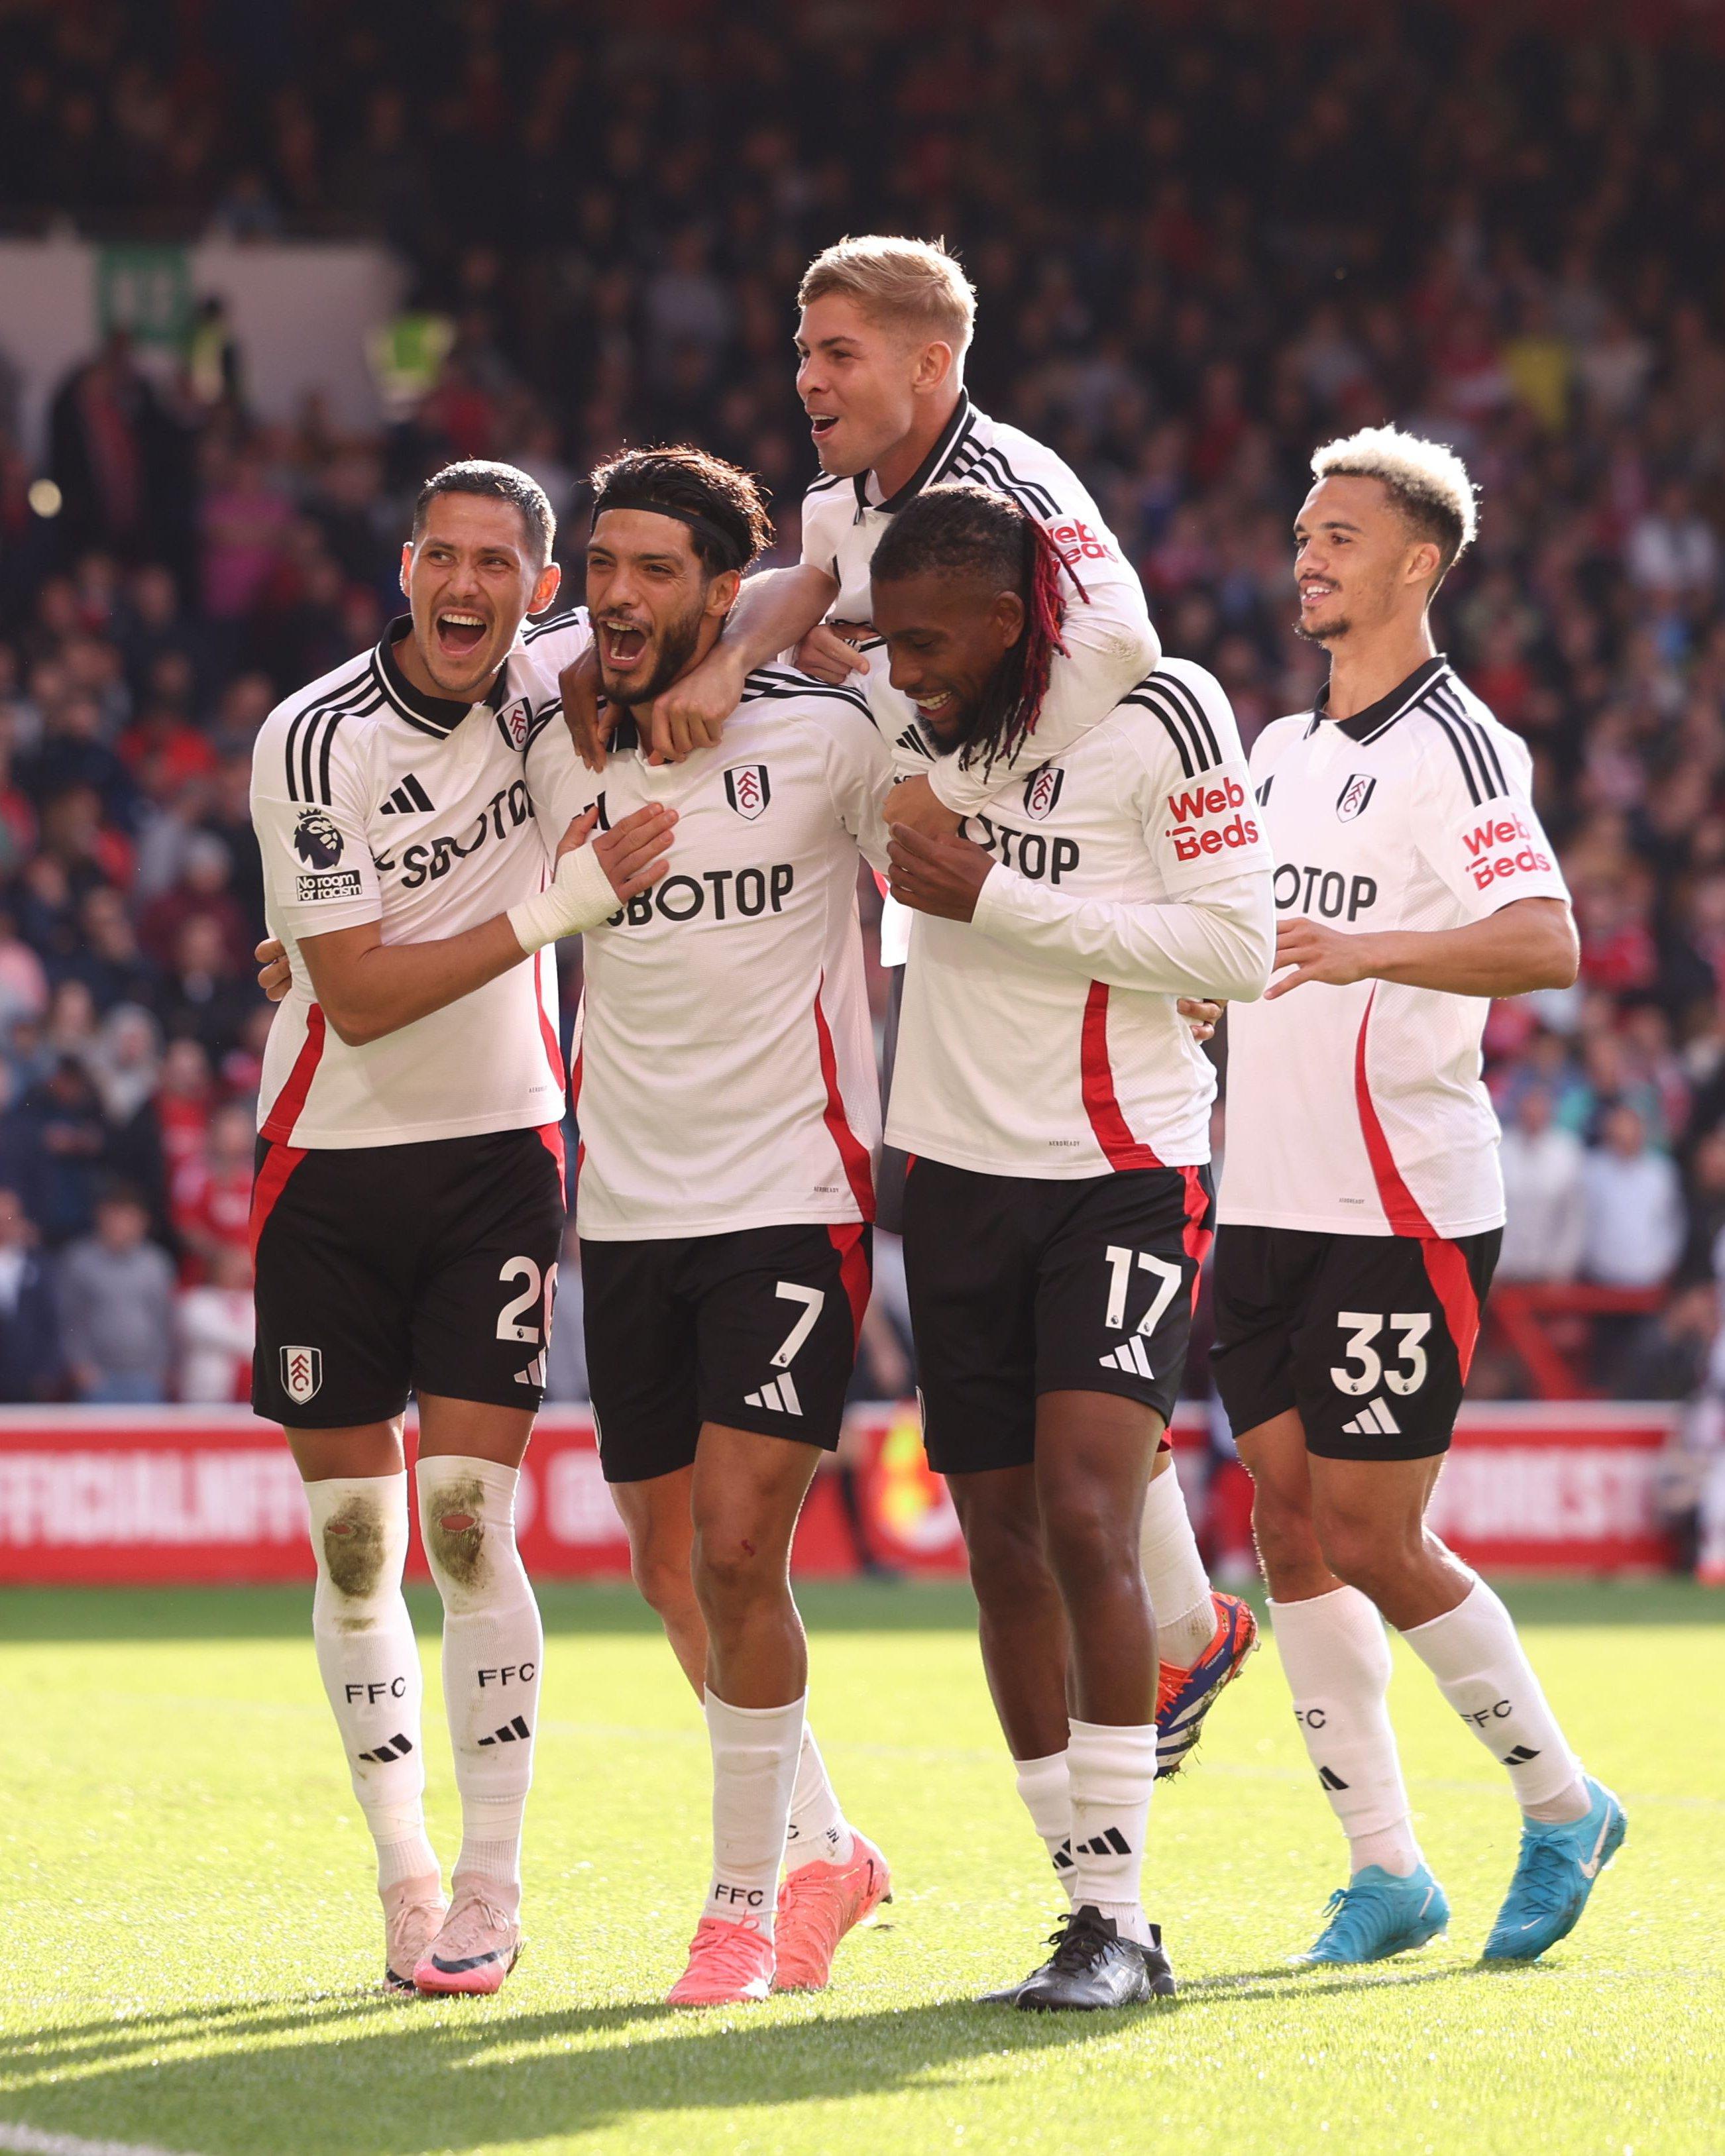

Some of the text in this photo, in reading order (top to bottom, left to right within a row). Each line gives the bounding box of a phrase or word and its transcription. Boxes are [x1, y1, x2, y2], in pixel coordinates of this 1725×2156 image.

[1168, 777, 1245, 823] Web
[1166, 814, 1258, 861] Beds
[1462, 812, 1531, 856] Web
[296, 874, 355, 889] No room
[1465, 845, 1551, 890] Beds
[298, 885, 362, 900] for racism
[1105, 1245, 1182, 1337] 17
[769, 1281, 825, 1368] 7
[1330, 1311, 1432, 1395] 33
[345, 1677, 406, 1704] FFC
[478, 1662, 535, 1688] FFC
[715, 1884, 764, 1907] FFC
